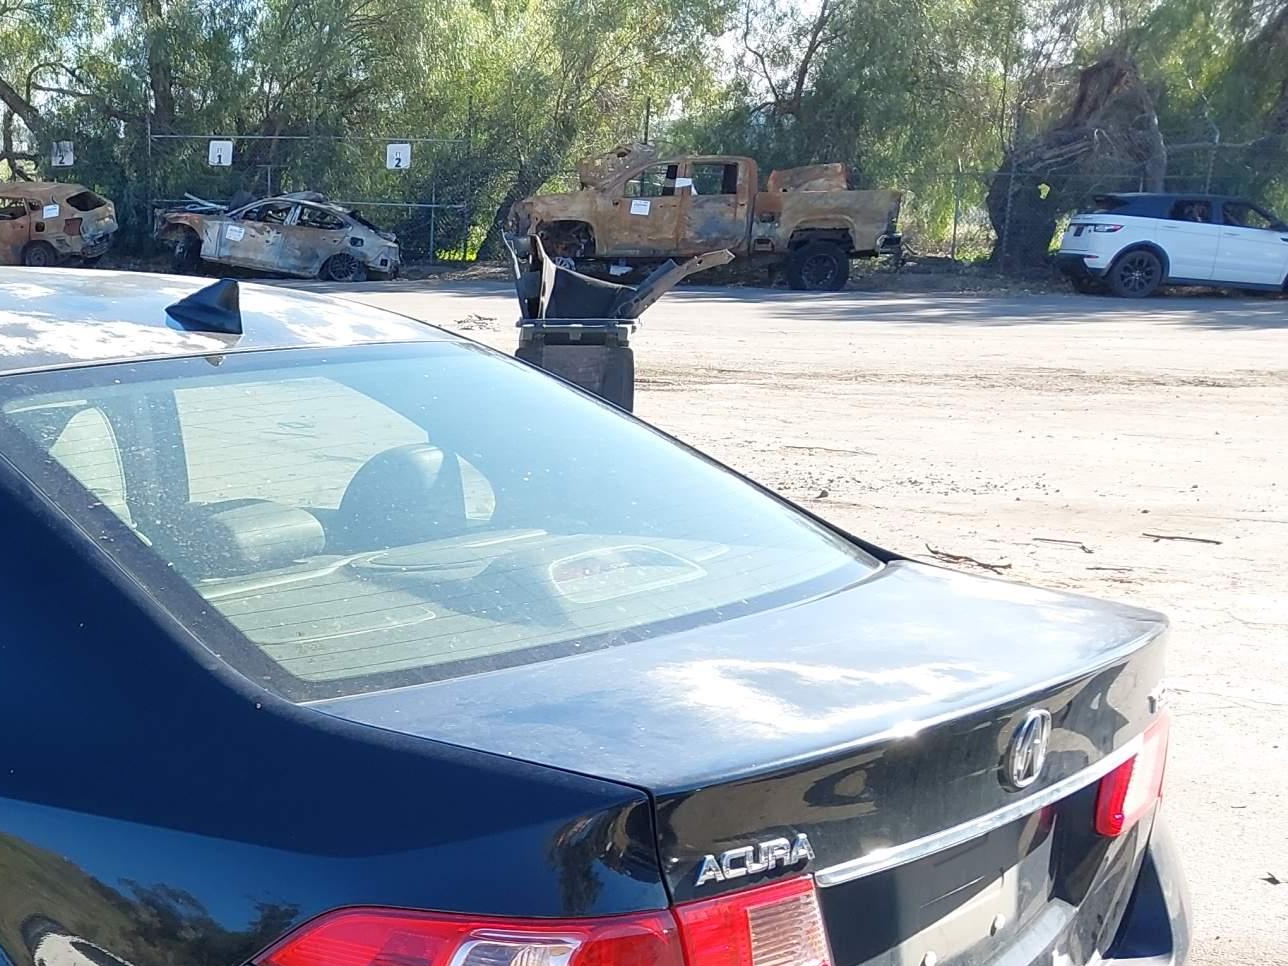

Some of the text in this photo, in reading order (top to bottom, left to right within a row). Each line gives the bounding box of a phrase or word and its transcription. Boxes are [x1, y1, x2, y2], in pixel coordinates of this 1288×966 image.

[217, 154, 223, 164] 1
[394, 157, 401, 168] 2
[695, 833, 816, 887] ACURA
